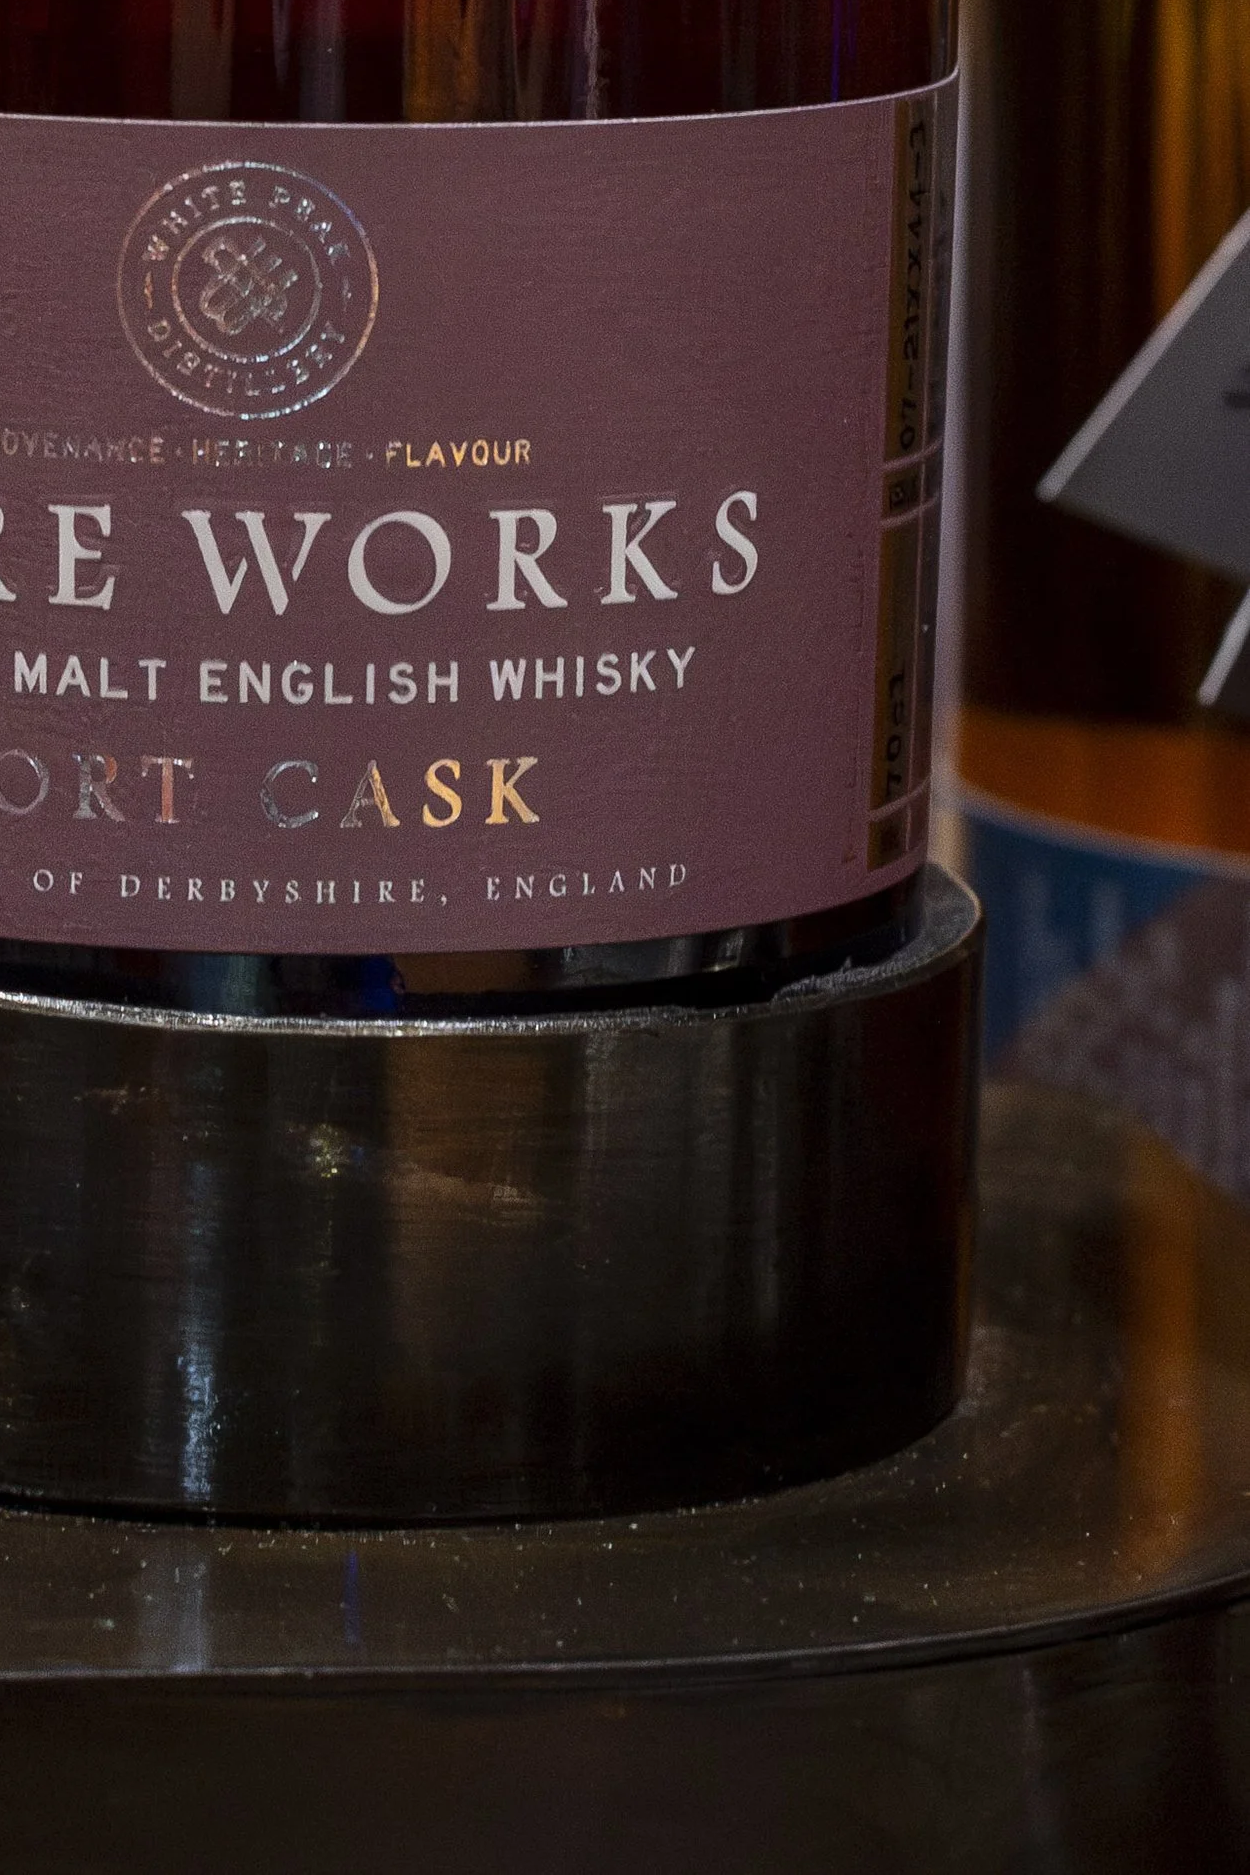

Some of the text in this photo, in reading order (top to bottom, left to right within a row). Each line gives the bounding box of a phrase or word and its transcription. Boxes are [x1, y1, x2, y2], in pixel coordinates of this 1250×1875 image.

[385, 439, 532, 468] FLAVOUR
[181, 490, 758, 615] WORKS
[13, 650, 167, 702] MALT
[199, 659, 459, 705] ENGLISH
[488, 645, 696, 701] WHISKY
[259, 755, 540, 829] CASK
[32, 868, 85, 895] OF
[120, 873, 449, 906] DERBYSHIRE,
[485, 862, 688, 900] ENGLAND
